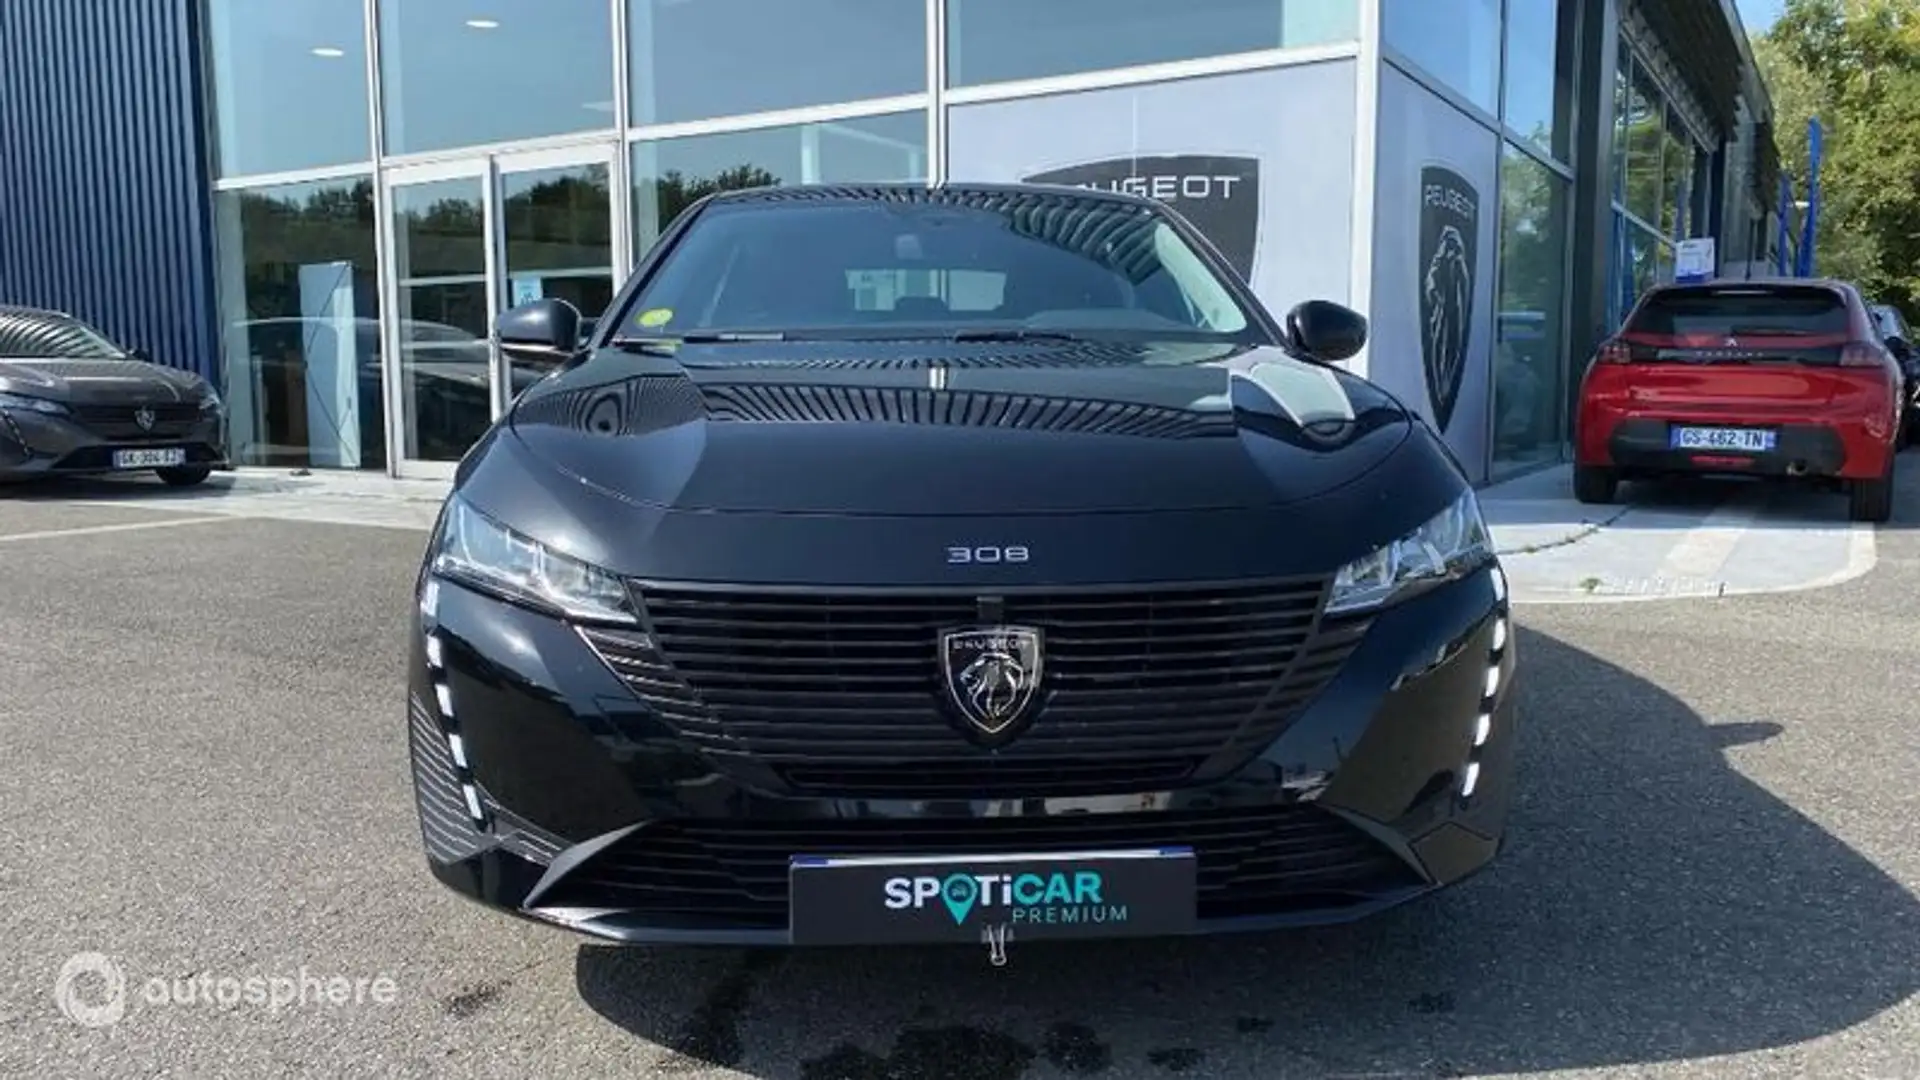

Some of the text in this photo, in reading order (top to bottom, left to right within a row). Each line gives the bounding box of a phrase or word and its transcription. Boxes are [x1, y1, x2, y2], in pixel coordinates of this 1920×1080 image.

[1424, 184, 1476, 219] PEUGEOT
[947, 547, 1029, 563] 308
[1012, 905, 1128, 924] PREMIUM
